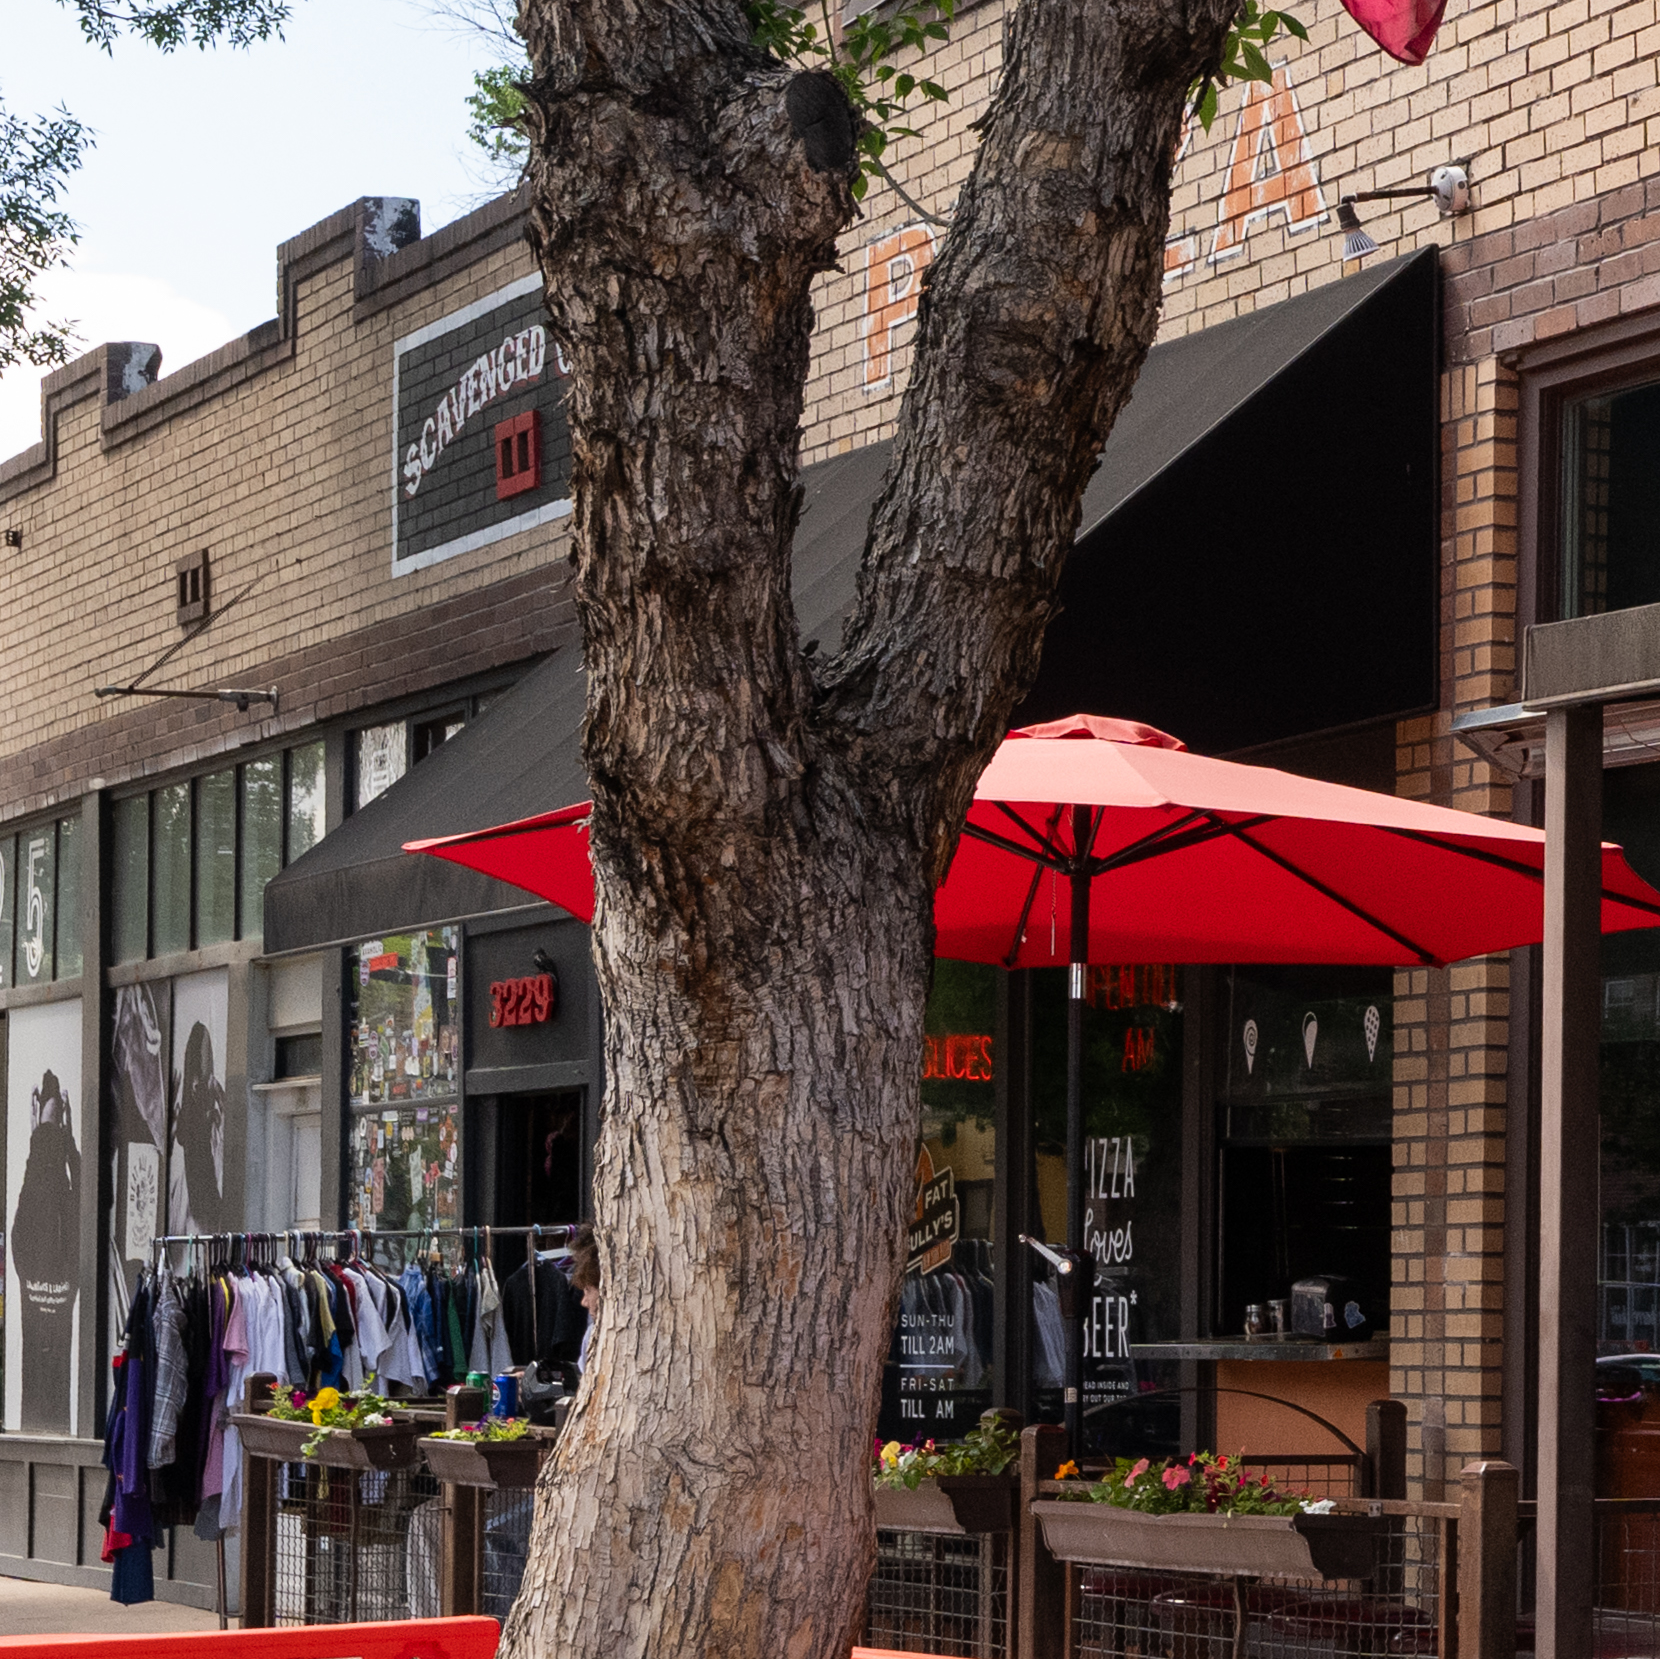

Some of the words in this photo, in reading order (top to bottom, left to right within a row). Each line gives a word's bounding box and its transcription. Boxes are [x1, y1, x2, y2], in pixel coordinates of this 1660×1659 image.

[404, 324, 547, 496] SCAVENGED
[489, 973, 554, 1028] 3229
[1086, 962, 1135, 1010] PEN
[1084, 1136, 1135, 1199] IZZA
[925, 1179, 950, 1210] FAT
[909, 1210, 954, 1252] ULLY'S
[901, 1314, 955, 1328] SUN-THU
[901, 1336, 926, 1355] TILL
[929, 1335, 955, 1355] 2AM
[901, 1377, 954, 1392] FRI-SAT
[1098, 1381, 1116, 1390] INSIDE
[901, 1399, 926, 1418] TILL
[936, 1399, 955, 1419] AM
